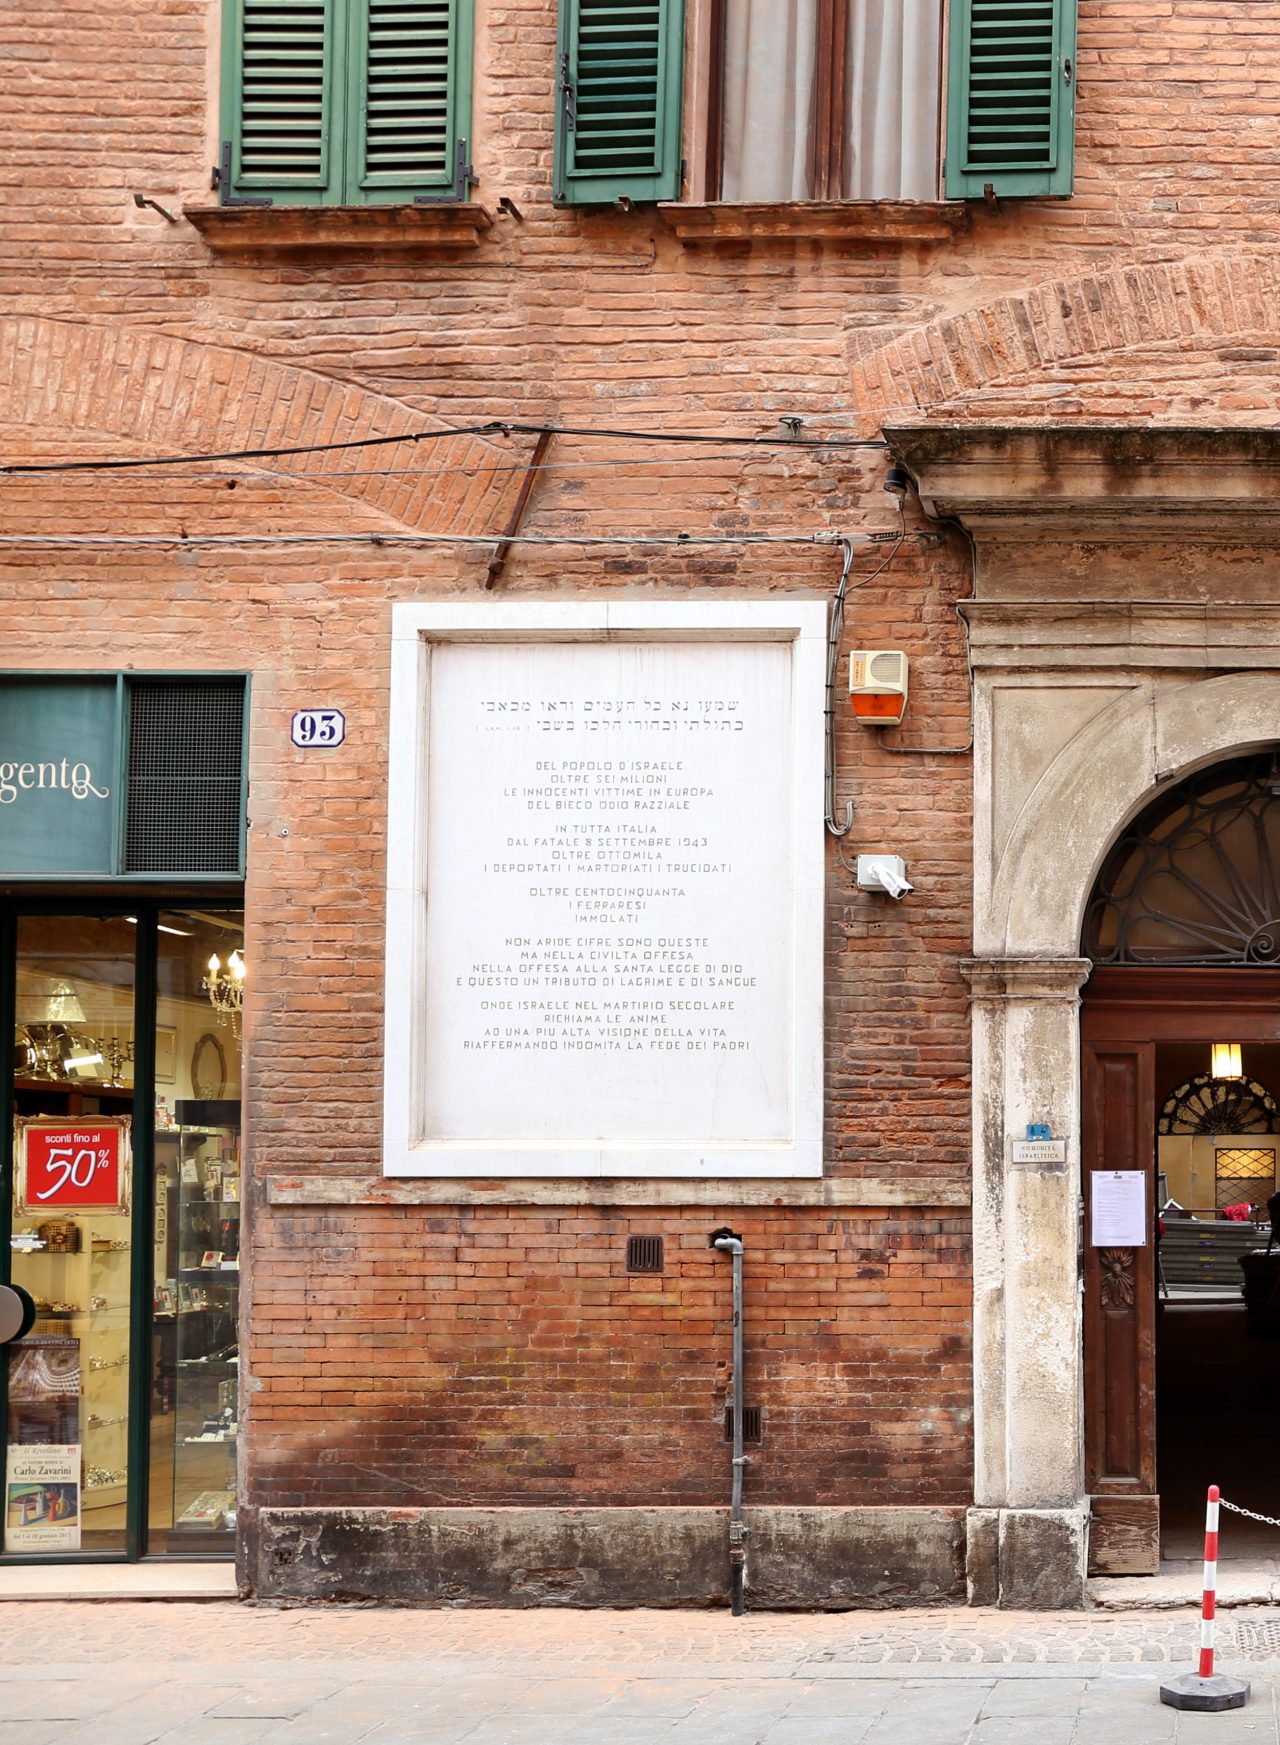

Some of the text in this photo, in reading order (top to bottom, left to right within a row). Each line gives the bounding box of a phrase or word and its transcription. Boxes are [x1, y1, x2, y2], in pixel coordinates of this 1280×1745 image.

[300, 714, 337, 742] 93
[535, 760, 556, 770] DEL
[562, 761, 612, 770] POPOLO
[550, 774, 666, 784] OLTRE SEI MILIONI
[503, 787, 714, 796] LE INNOCENTI VITTIME IN EUROPA
[527, 800, 690, 810] DEL BIECO ODIO RAZZIALE
[555, 824, 656, 833] IN TUTTA ITALIA
[506, 837, 707, 848] DAL FATALE 8 SETTEMBRE 1943
[551, 850, 662, 860] OLTRE OTTOMILA
[493, 863, 560, 872] DEPORTATI
[576, 863, 652, 872] MARTORIATI
[666, 863, 731, 872] TRUCIDATI
[529, 887, 685, 898] OLTRE CENTOCINQUANTA
[576, 900, 646, 910] FERRARESI
[575, 913, 638, 923] IMMOLATI
[505, 937, 708, 948] NON ARIDE CIFRE SONO QUESTE
[520, 951, 538, 959] MA
[543, 950, 584, 960] NELLA
[643, 950, 693, 960] OFFESA
[472, 963, 742, 973] NELLA OFFESA ALLA SANTA LEGGE DI DIO
[468, 976, 518, 988] QUESTO
[523, 977, 539, 986] UN
[544, 976, 596, 986] TRIBUTO
[602, 977, 614, 986] DI
[620, 976, 672, 986] LAGRIME
[678, 977, 685, 986] E
[690, 977, 702, 986] DI
[708, 976, 757, 986] SANGUE
[480, 1000, 734, 1010] ONDE ISRAELE NEL MARTIRIO SECOLARE
[544, 1014, 666, 1024] RICHIAMA LE ANIME
[484, 1027, 499, 1036] AD
[505, 1027, 529, 1036] UNA
[561, 1027, 590, 1036] ALTA
[598, 1027, 648, 1038] VISIONE
[654, 1027, 692, 1036] DELLA
[698, 1027, 726, 1037] VITA
[463, 1040, 749, 1051] RIAFFERMANDO INDOMITA LA FEDE DEI PADRI
[45, 1133, 101, 1144] sconti fino al
[36, 1148, 109, 1200] 50%
[14, 1466, 72, 1476] Carlo Zavarini
